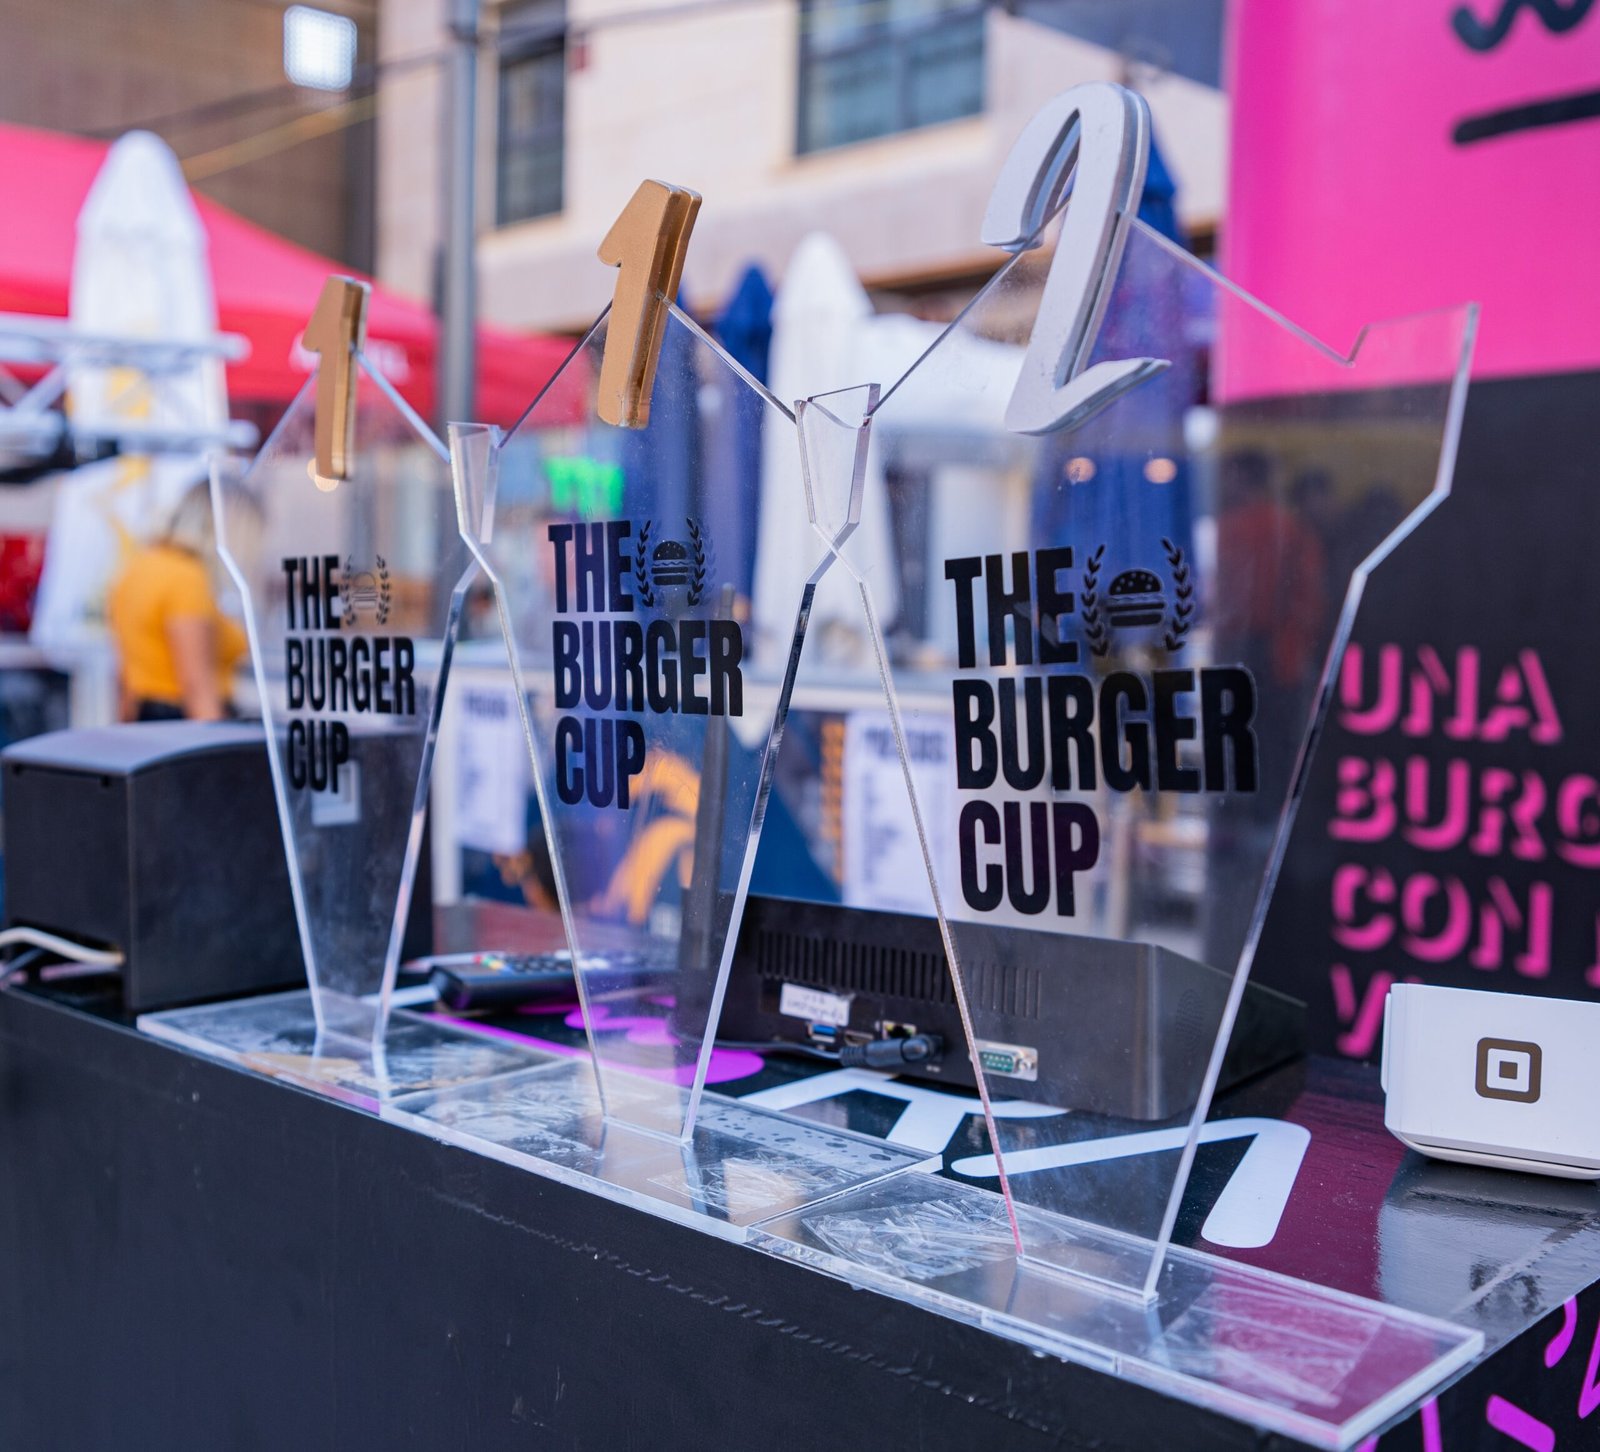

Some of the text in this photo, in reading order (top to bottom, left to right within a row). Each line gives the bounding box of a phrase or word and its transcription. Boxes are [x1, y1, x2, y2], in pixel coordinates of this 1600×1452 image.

[597, 179, 702, 429] 1
[981, 81, 1172, 436] 2
[302, 275, 371, 480] 1
[282, 554, 341, 630] THE
[548, 520, 634, 613] THE
[945, 546, 1079, 668] THE
[285, 636, 415, 714] BURGER
[553, 619, 743, 717] BURGER
[1338, 641, 1562, 744] UNA
[287, 719, 349, 794] CUP
[556, 716, 646, 810] CUP
[953, 668, 1258, 792] BURGER
[959, 800, 1100, 917] CUP
[1331, 862, 1553, 979] CON
